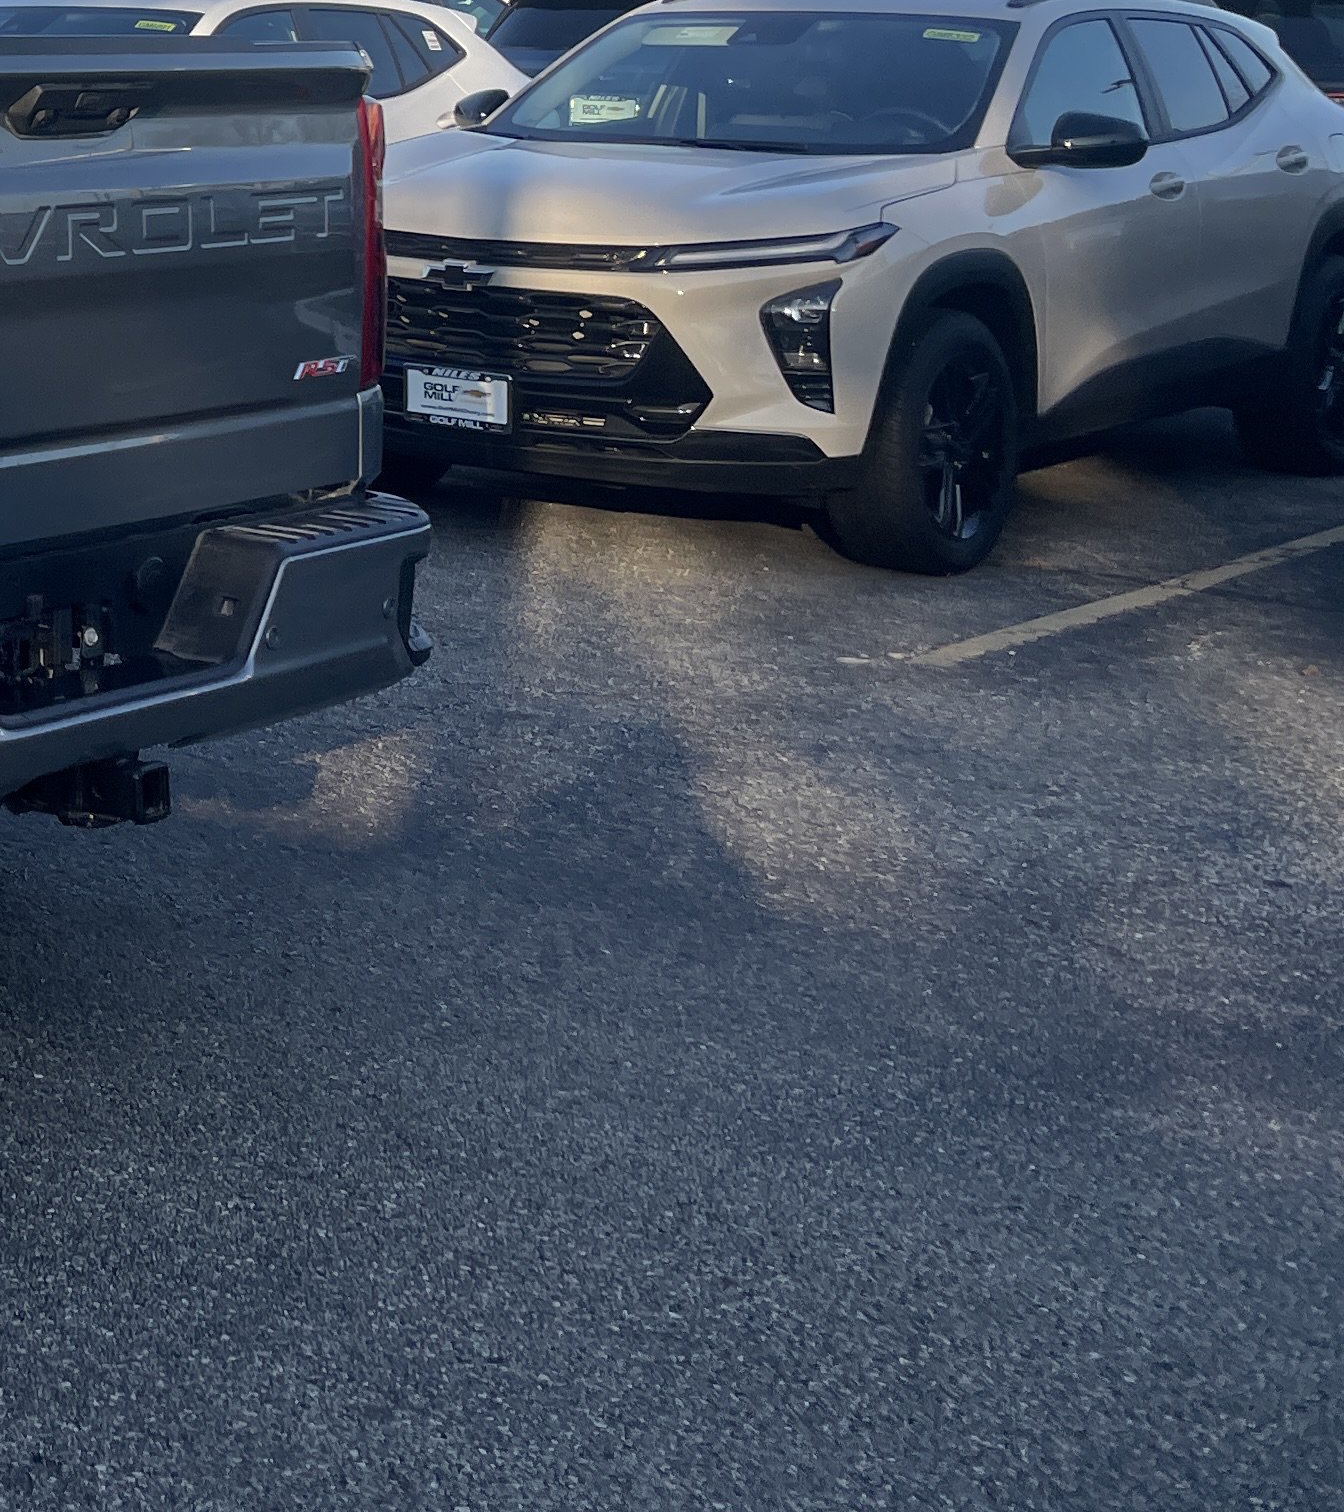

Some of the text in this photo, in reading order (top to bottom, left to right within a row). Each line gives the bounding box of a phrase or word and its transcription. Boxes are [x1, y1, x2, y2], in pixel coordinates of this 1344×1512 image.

[293, 354, 358, 381] RST
[431, 368, 482, 381] NILES
[423, 381, 461, 394] GOLF
[424, 390, 453, 402] MILL
[429, 415, 484, 430] GOLF MILL
